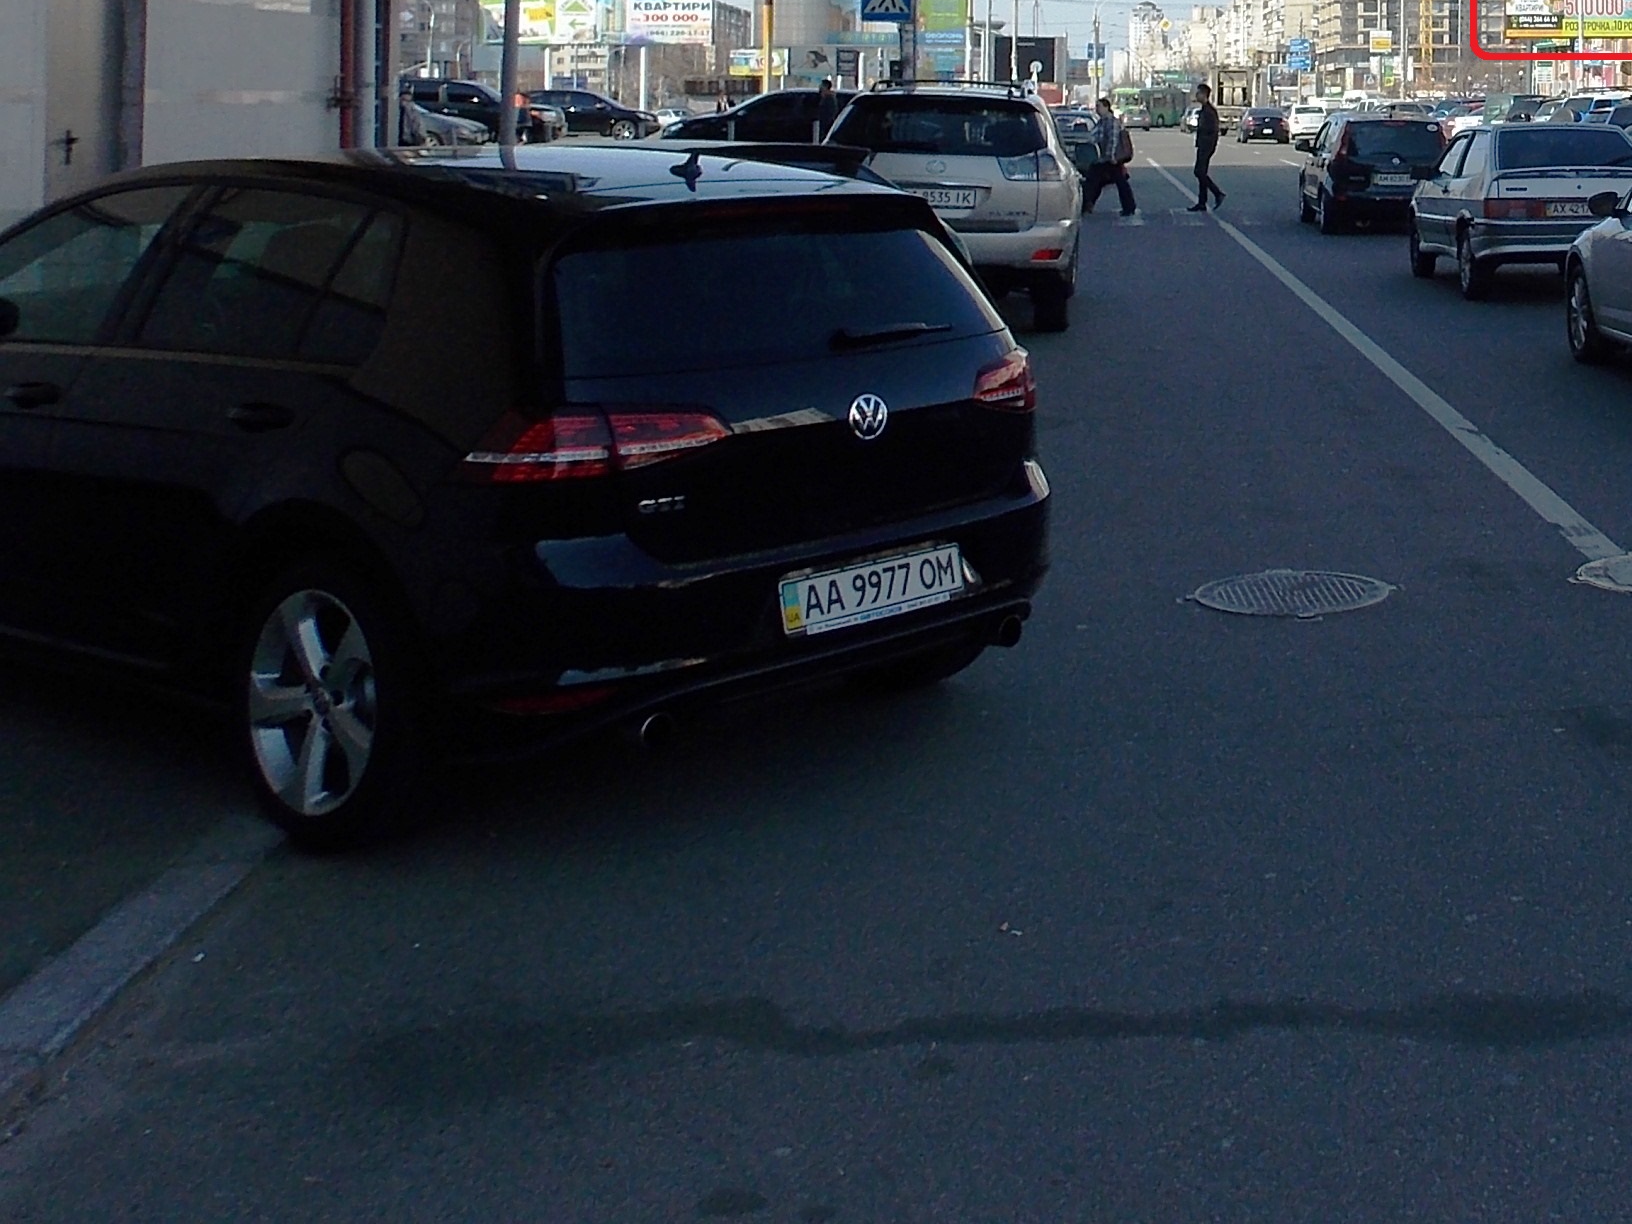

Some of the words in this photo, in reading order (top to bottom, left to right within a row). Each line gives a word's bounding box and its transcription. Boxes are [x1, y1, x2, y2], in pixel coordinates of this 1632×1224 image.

[633, 2, 711, 11] КВАРТИРИ
[672, 14, 699, 22] 000
[1565, 21, 1610, 31] РОЗТРОЧКА
[956, 192, 971, 204] IK
[1553, 204, 1567, 214] AX
[805, 579, 845, 619] AA
[852, 562, 911, 608] 9977
[919, 552, 956, 590] OM
